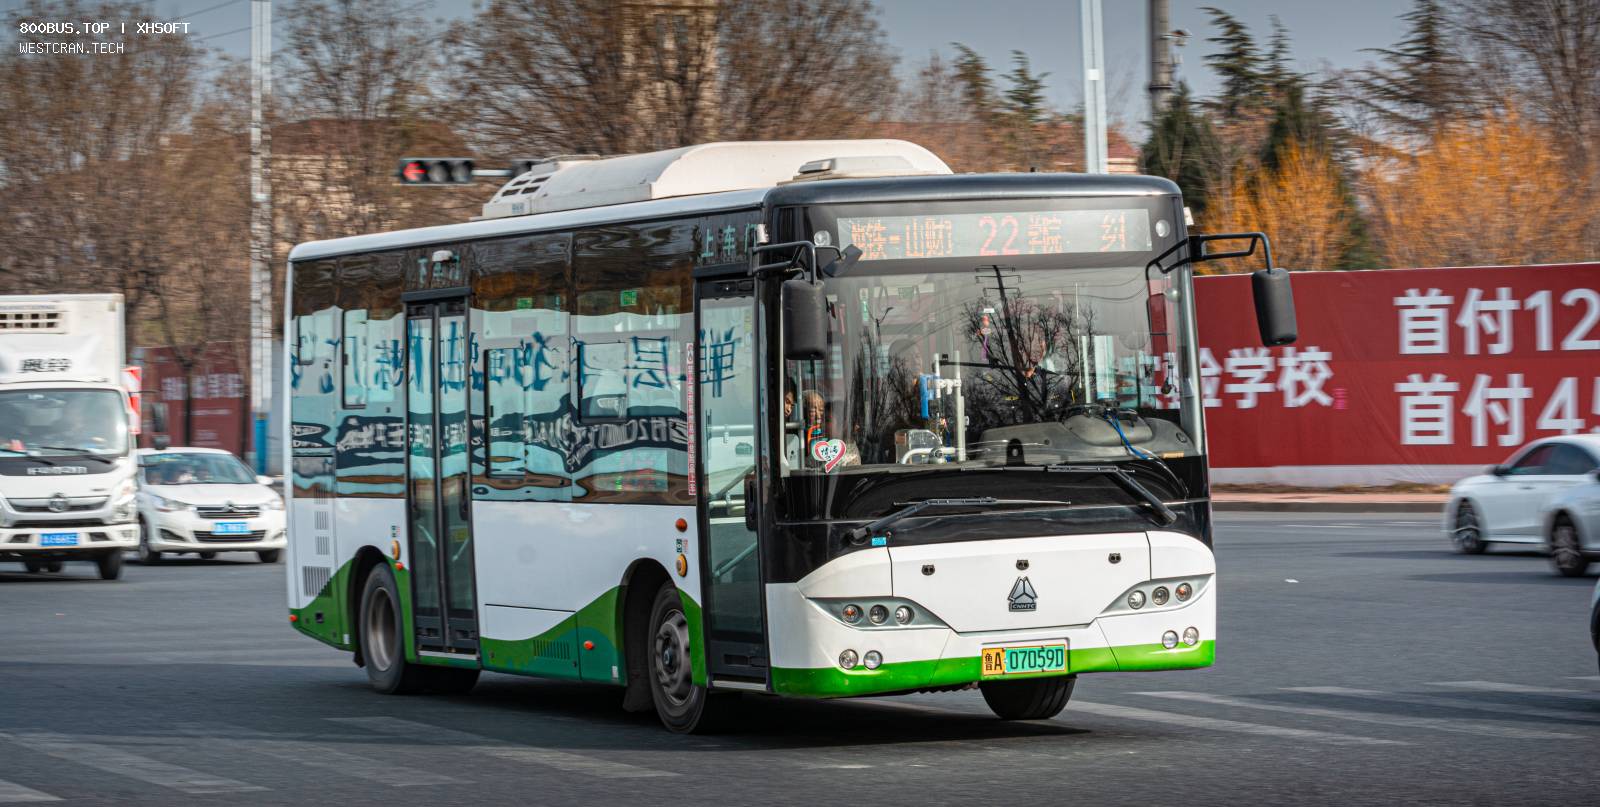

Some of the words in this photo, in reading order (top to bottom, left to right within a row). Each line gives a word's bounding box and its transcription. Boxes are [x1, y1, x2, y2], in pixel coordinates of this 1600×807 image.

[977, 214, 1020, 257] 22
[1393, 286, 1600, 355] 首付12
[1394, 372, 1600, 447] 首付4
[984, 651, 1003, 671] 鲁A
[1009, 648, 1064, 670] 07059D
